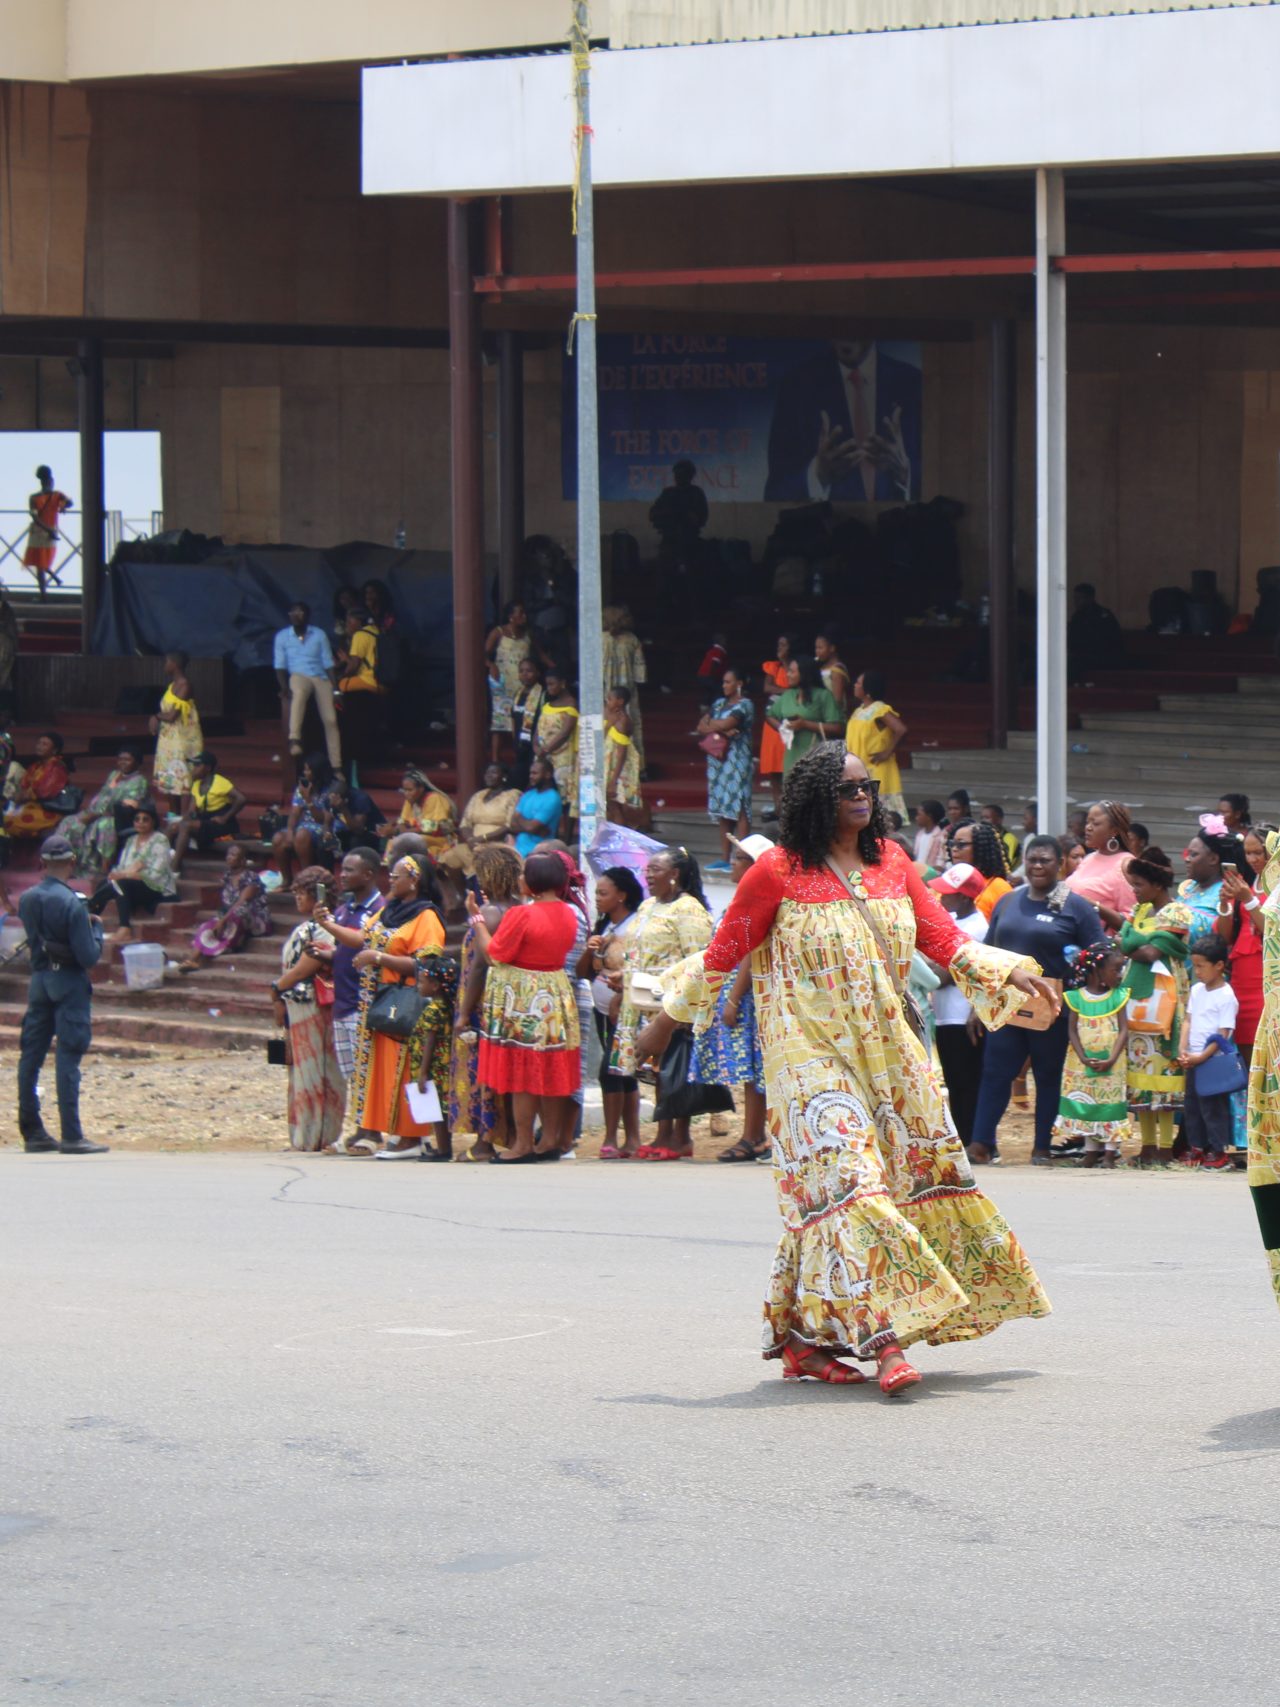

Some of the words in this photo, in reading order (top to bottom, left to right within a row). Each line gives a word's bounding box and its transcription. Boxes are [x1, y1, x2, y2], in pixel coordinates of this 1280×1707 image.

[632, 335, 656, 354] LA
[599, 365, 627, 391] DE
[609, 429, 651, 455] THE
[657, 428, 719, 454] FORCE
